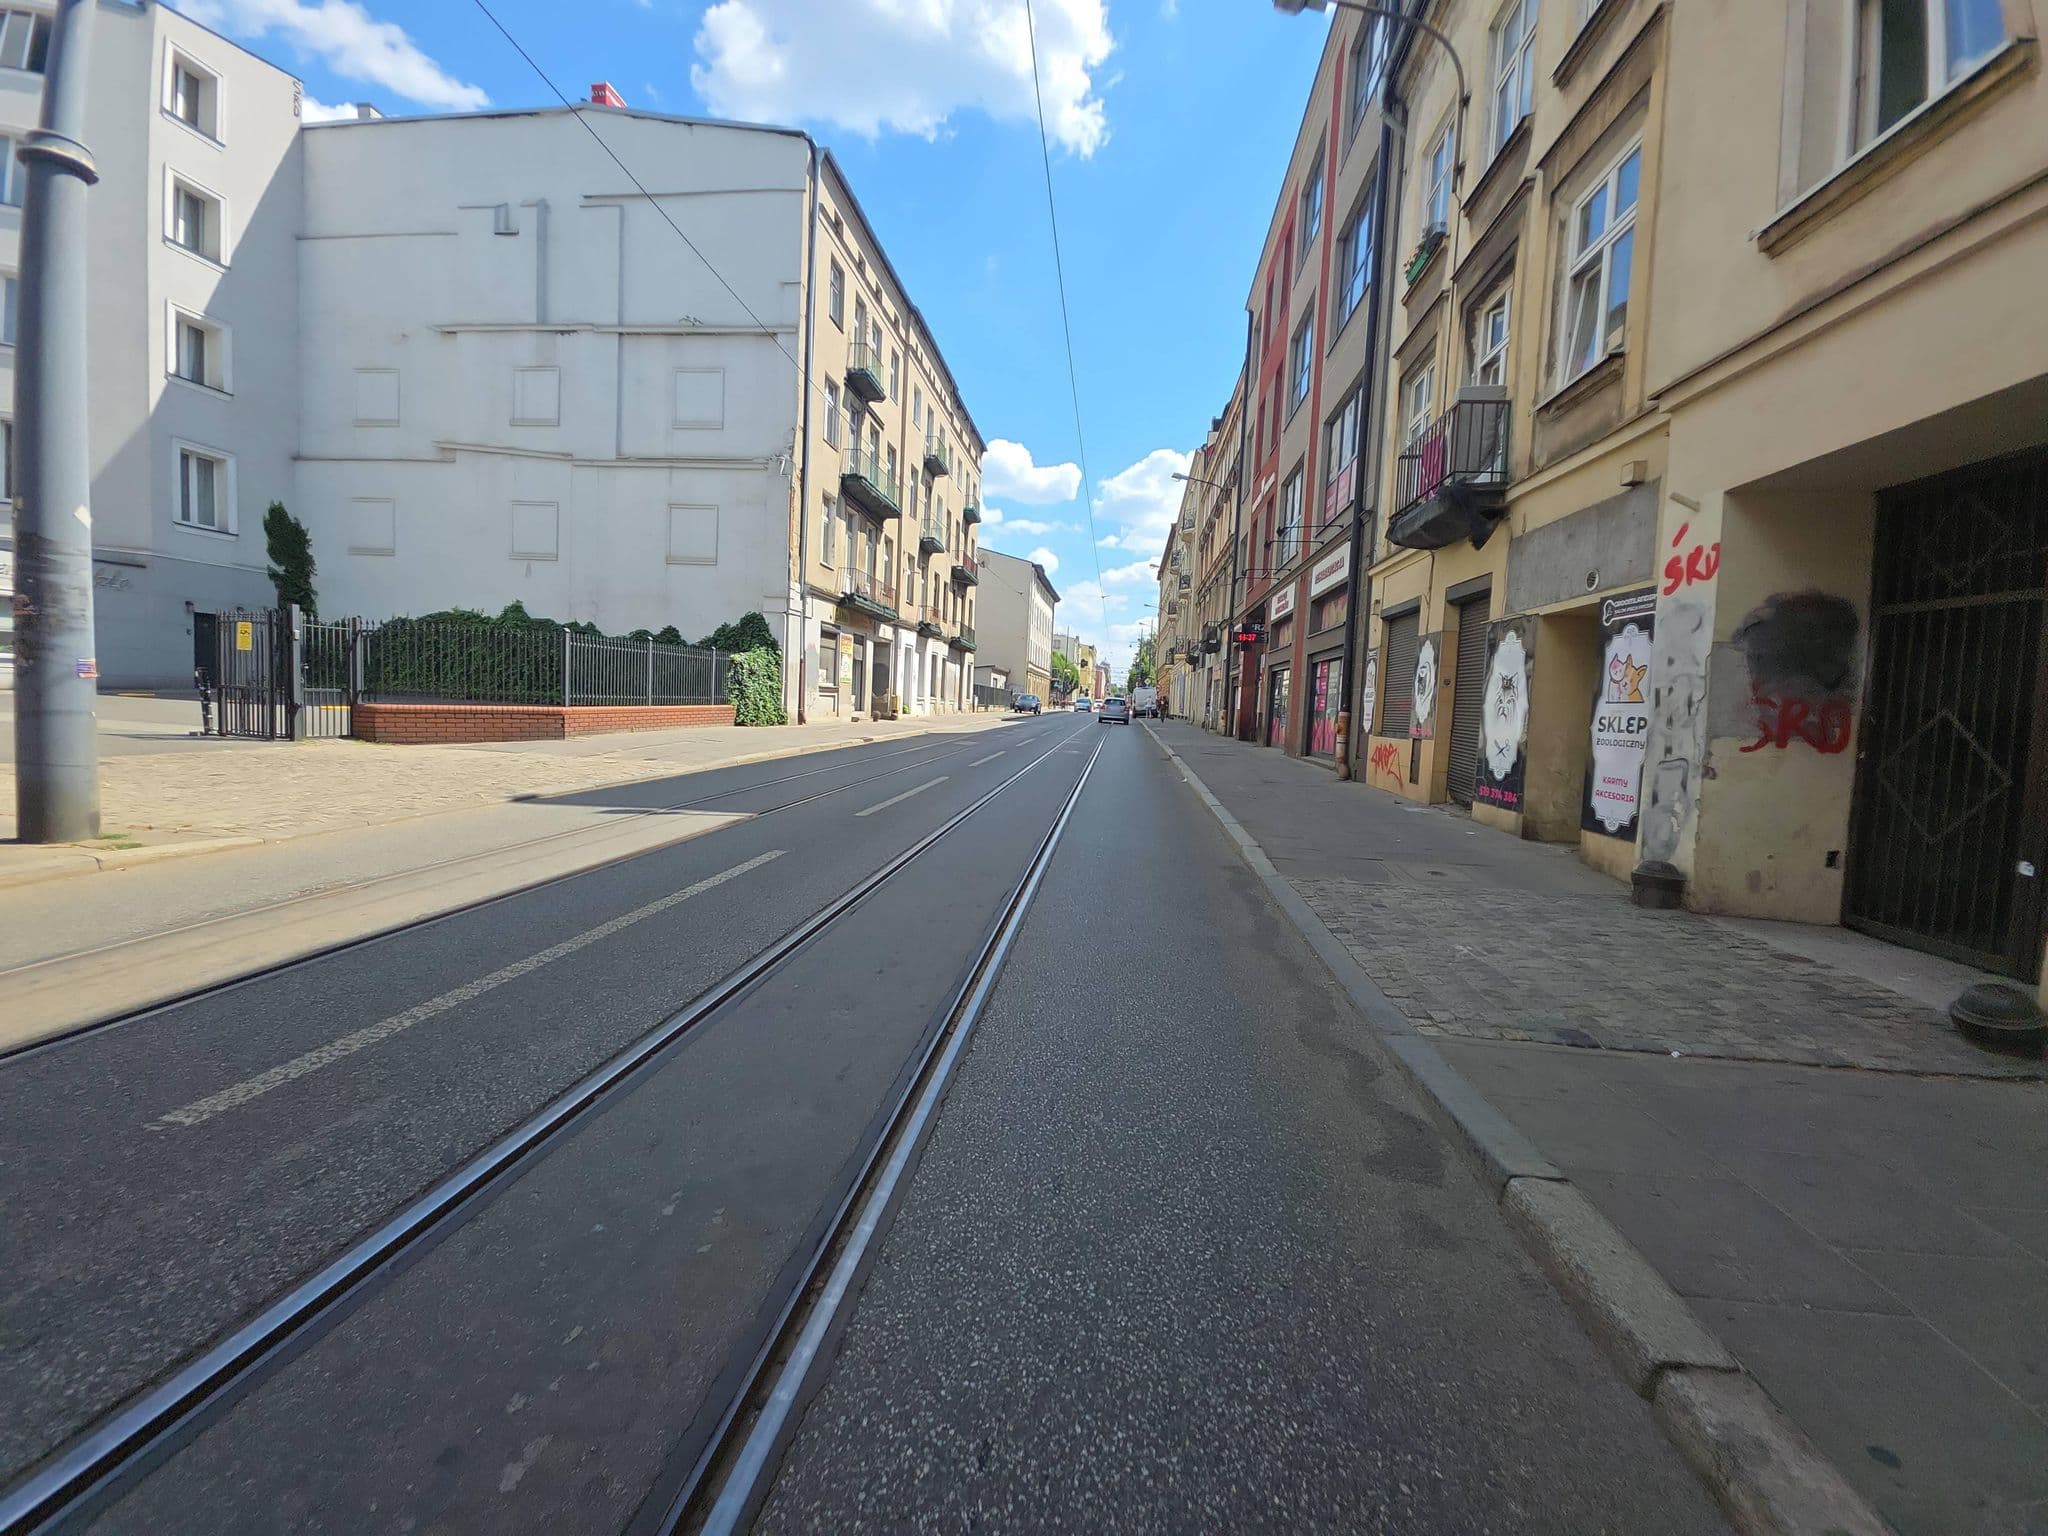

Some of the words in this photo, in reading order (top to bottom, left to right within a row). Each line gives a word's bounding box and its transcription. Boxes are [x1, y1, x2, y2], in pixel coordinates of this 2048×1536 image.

[1597, 716, 1647, 734] SKLEP
[1596, 738, 1645, 750] ZOOLOGICZNY
[1603, 776, 1629, 788] KARMY
[1595, 789, 1635, 803] AKCESORIA
